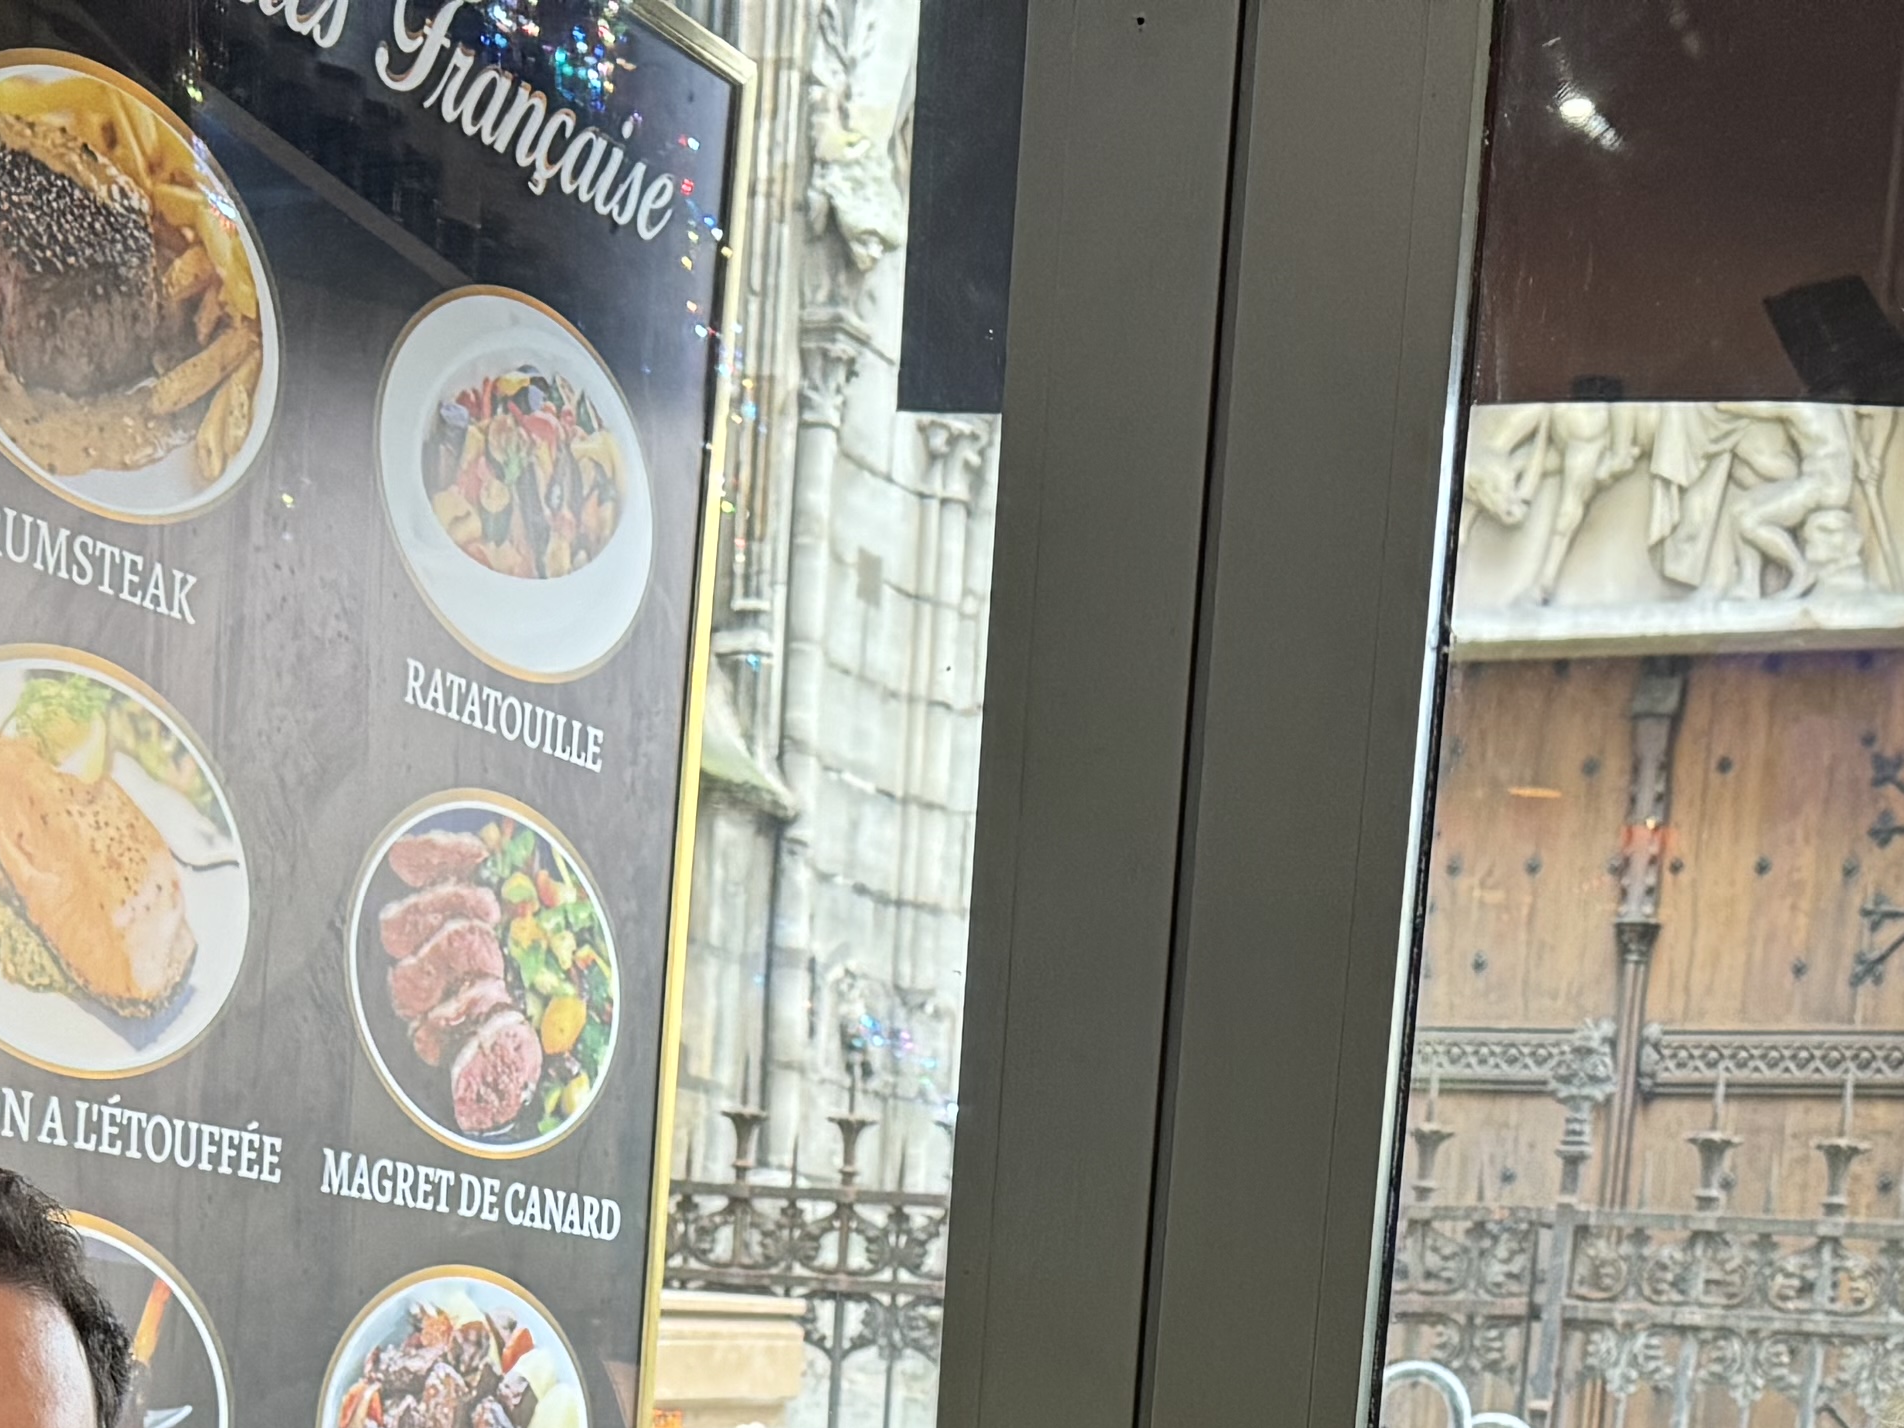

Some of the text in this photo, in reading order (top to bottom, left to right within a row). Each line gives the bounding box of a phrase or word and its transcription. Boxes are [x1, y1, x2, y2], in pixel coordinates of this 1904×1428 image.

[404, 658, 604, 773] RATATOUILLE
[37, 1095, 68, 1146] A
[74, 1093, 282, 1184] L'ÉTOUFFÉE
[320, 1147, 621, 1241] MAGRET DE CANARD
